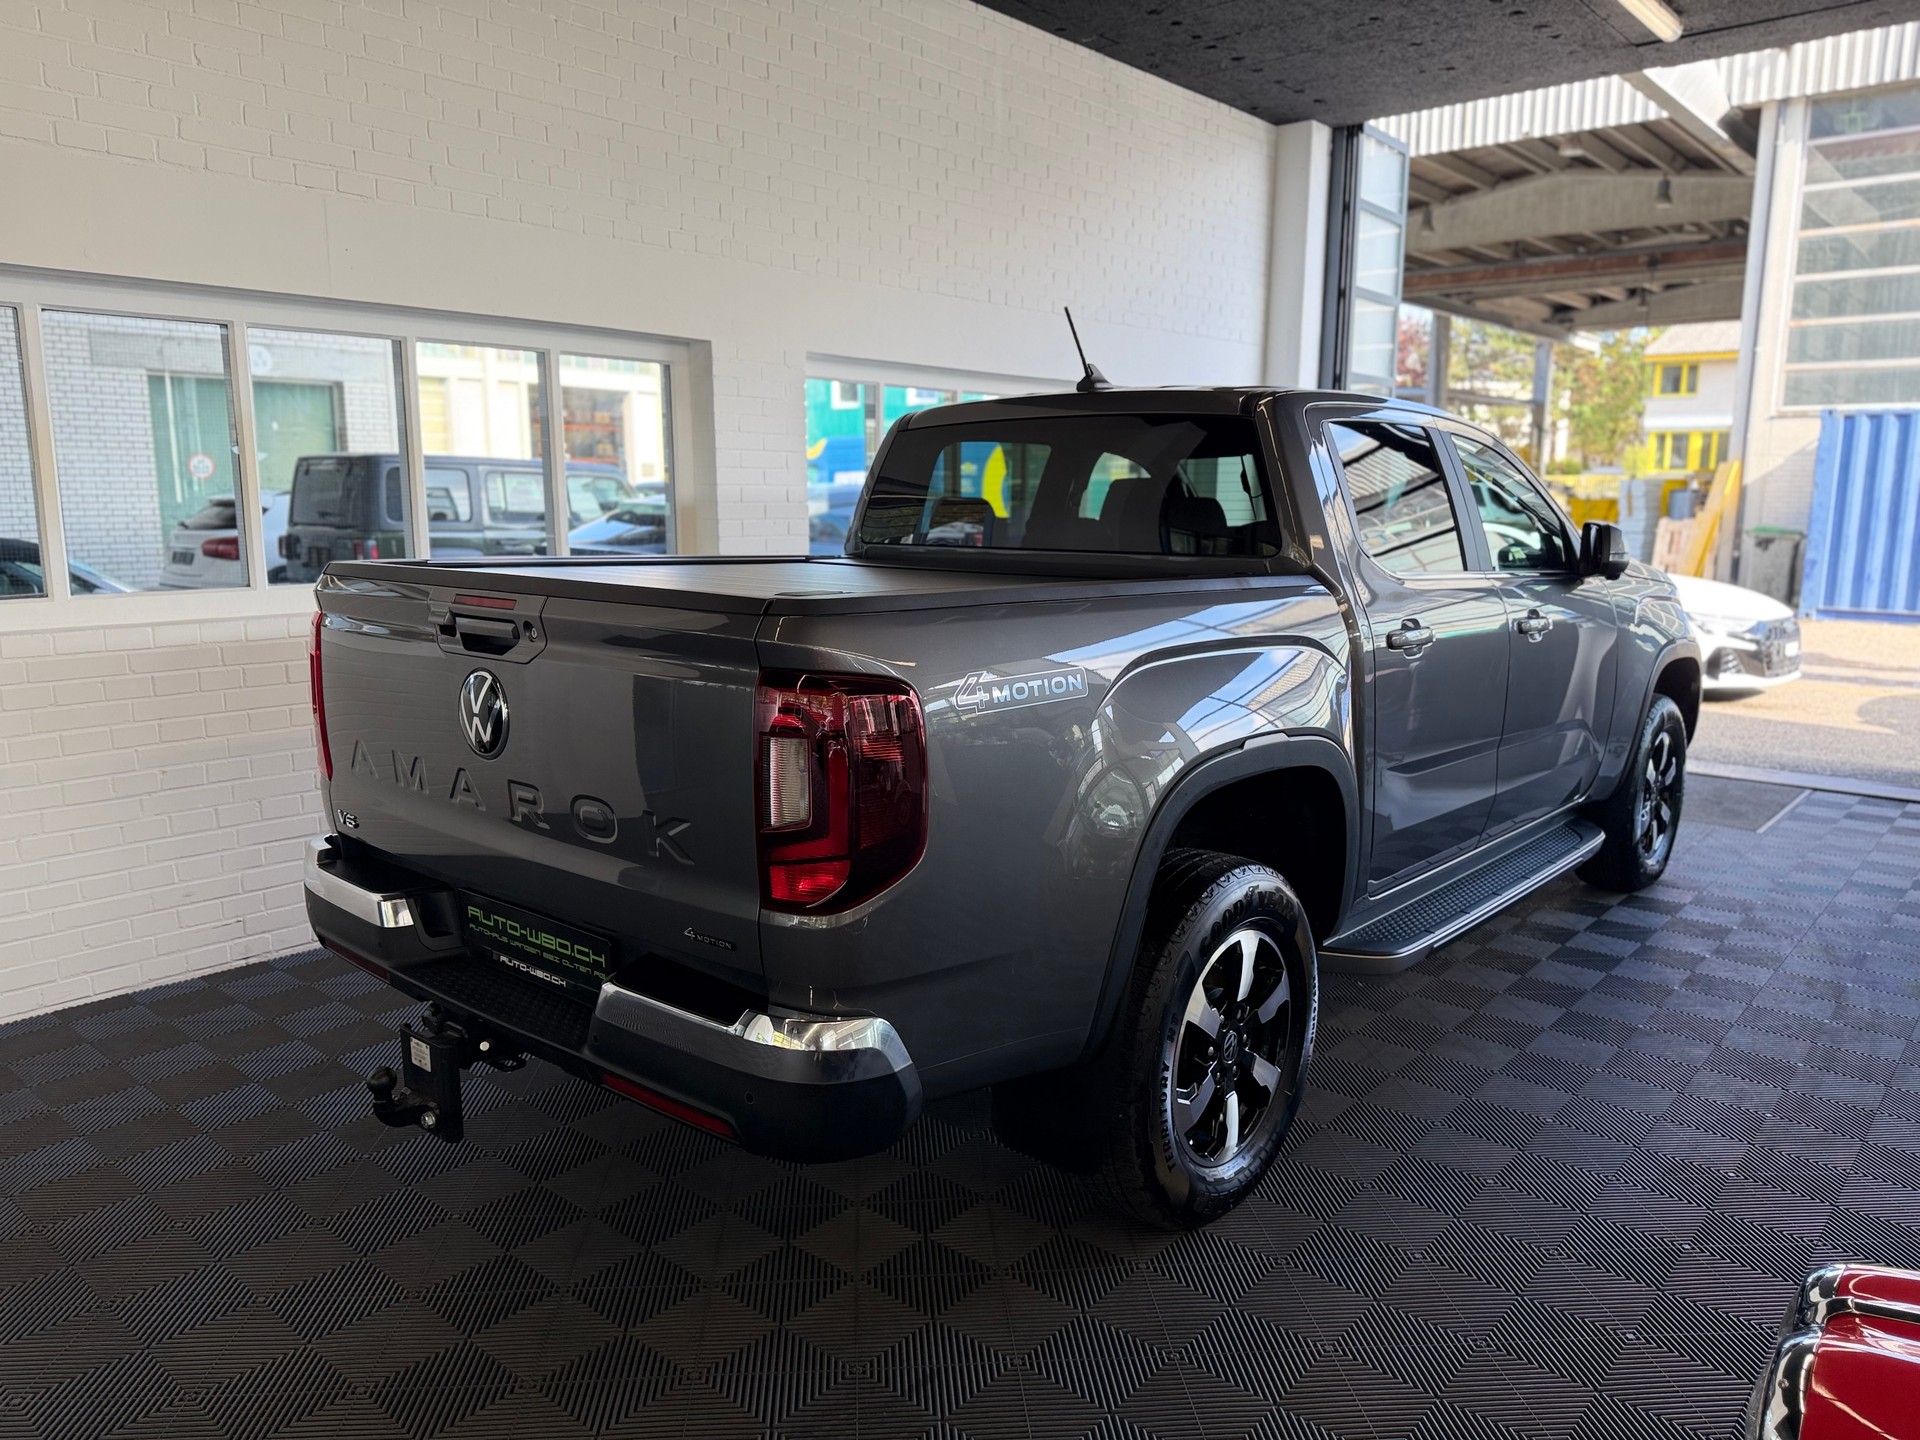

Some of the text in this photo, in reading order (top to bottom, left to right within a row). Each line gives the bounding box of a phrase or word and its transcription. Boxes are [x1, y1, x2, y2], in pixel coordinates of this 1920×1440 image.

[954, 671, 1083, 710] 4MOTION
[337, 809, 357, 828] V6
[352, 739, 695, 865] AMAROK
[468, 905, 605, 968] AUTO-WBO.CH
[469, 923, 508, 943] AUTOHAUS
[510, 940, 541, 957] WANGEN
[543, 952, 560, 963] BEI
[562, 959, 591, 974] OLTEN
[684, 927, 732, 949] 4MOTION
[500, 955, 567, 988] AUTO-WBO.CH
[1160, 1060, 1176, 1174] TERRITORY
